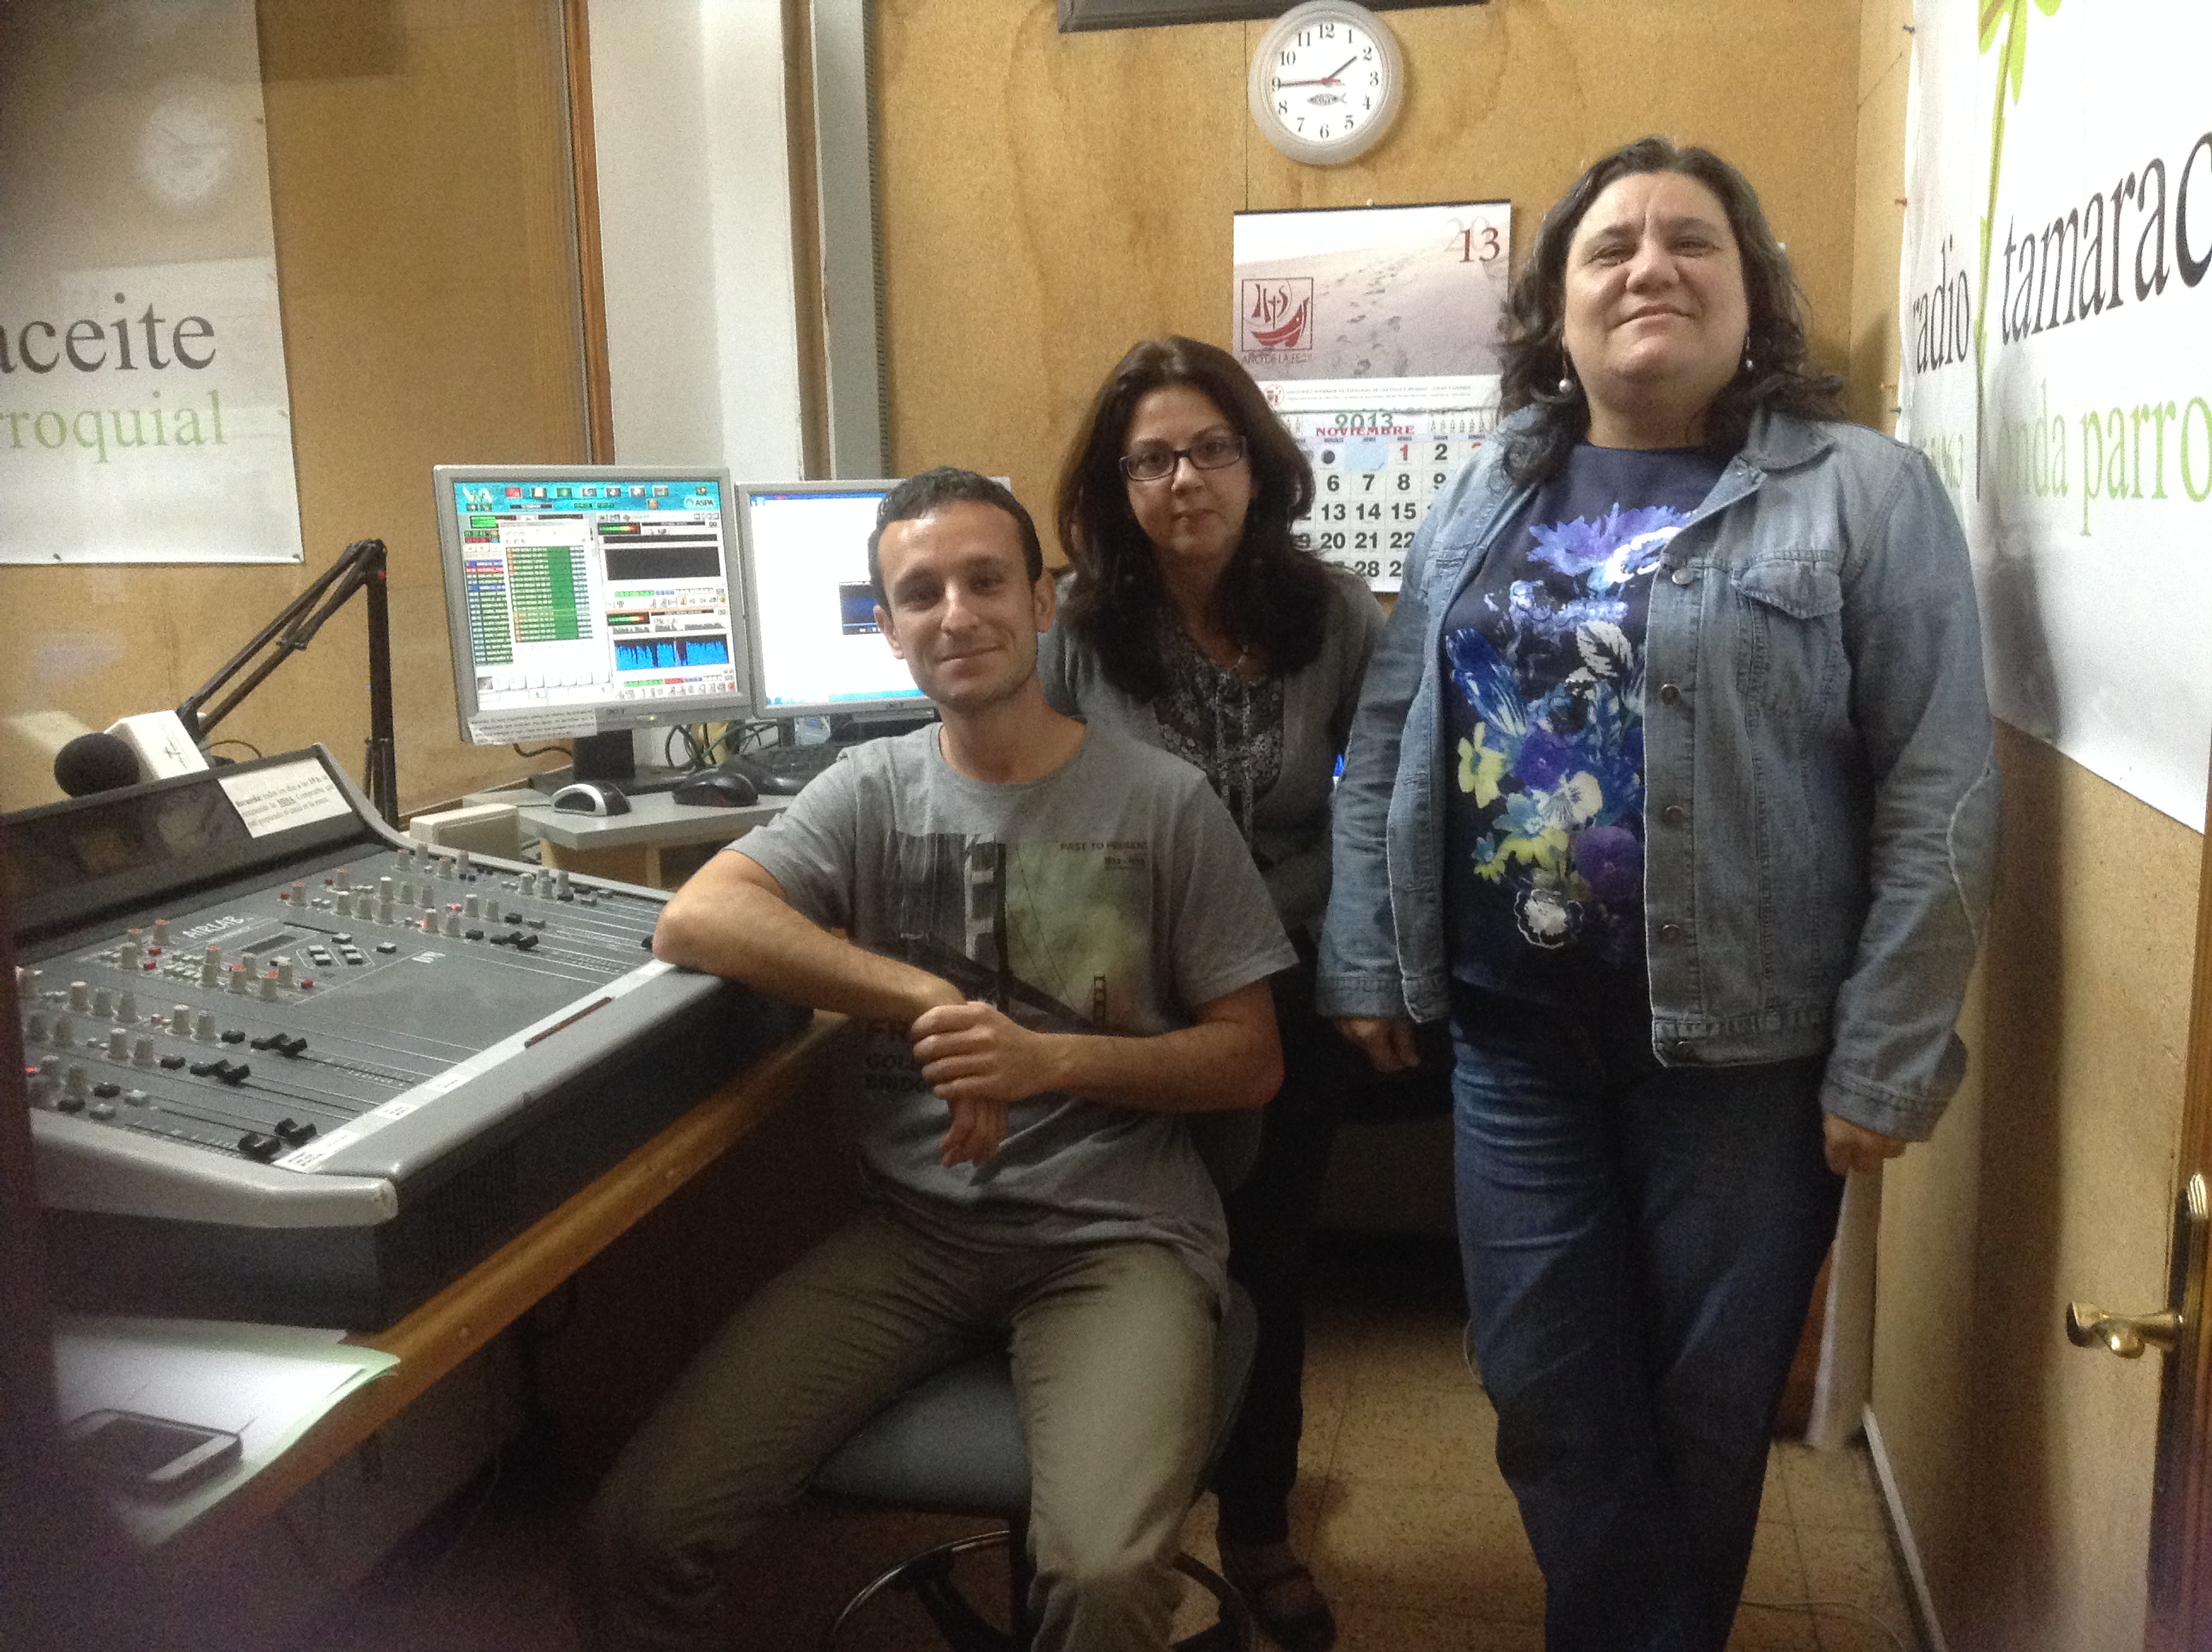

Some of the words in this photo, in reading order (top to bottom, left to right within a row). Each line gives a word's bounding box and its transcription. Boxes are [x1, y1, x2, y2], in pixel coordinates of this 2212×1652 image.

[1297, 31, 1311, 47] 11
[1318, 23, 1335, 39] 12
[1348, 29, 1353, 44] 1
[1280, 50, 1296, 66] 10
[1363, 46, 1372, 61] 2
[1272, 77, 1282, 92] 9
[1370, 71, 1379, 87] 3
[1278, 100, 1288, 115] 8
[1362, 94, 1371, 110] 4
[1296, 116, 1305, 132] 7
[1344, 114, 1354, 130] 5
[1319, 123, 1330, 139] 6
[1912, 234, 1970, 375] radio
[0, 389, 229, 467] roquial
[1335, 412, 1394, 428] 2013
[1316, 425, 1415, 436] NOVIEMBRE
[1400, 444, 1409, 462] 1
[1435, 443, 1448, 461] 2
[2080, 394, 2212, 537] parro
[1326, 474, 1340, 492] 6
[1362, 474, 1376, 492] 7
[1397, 473, 1411, 492] 8
[1321, 503, 1347, 521] 13
[1355, 503, 1382, 521] 14
[1391, 502, 1417, 520] 15
[1320, 532, 1347, 550] 20
[1354, 532, 1378, 550] 21
[1389, 532, 1415, 550] 22
[1354, 560, 1381, 578] 28
[1060, 843, 1087, 852] PAST
[1091, 843, 1104, 852] TO
